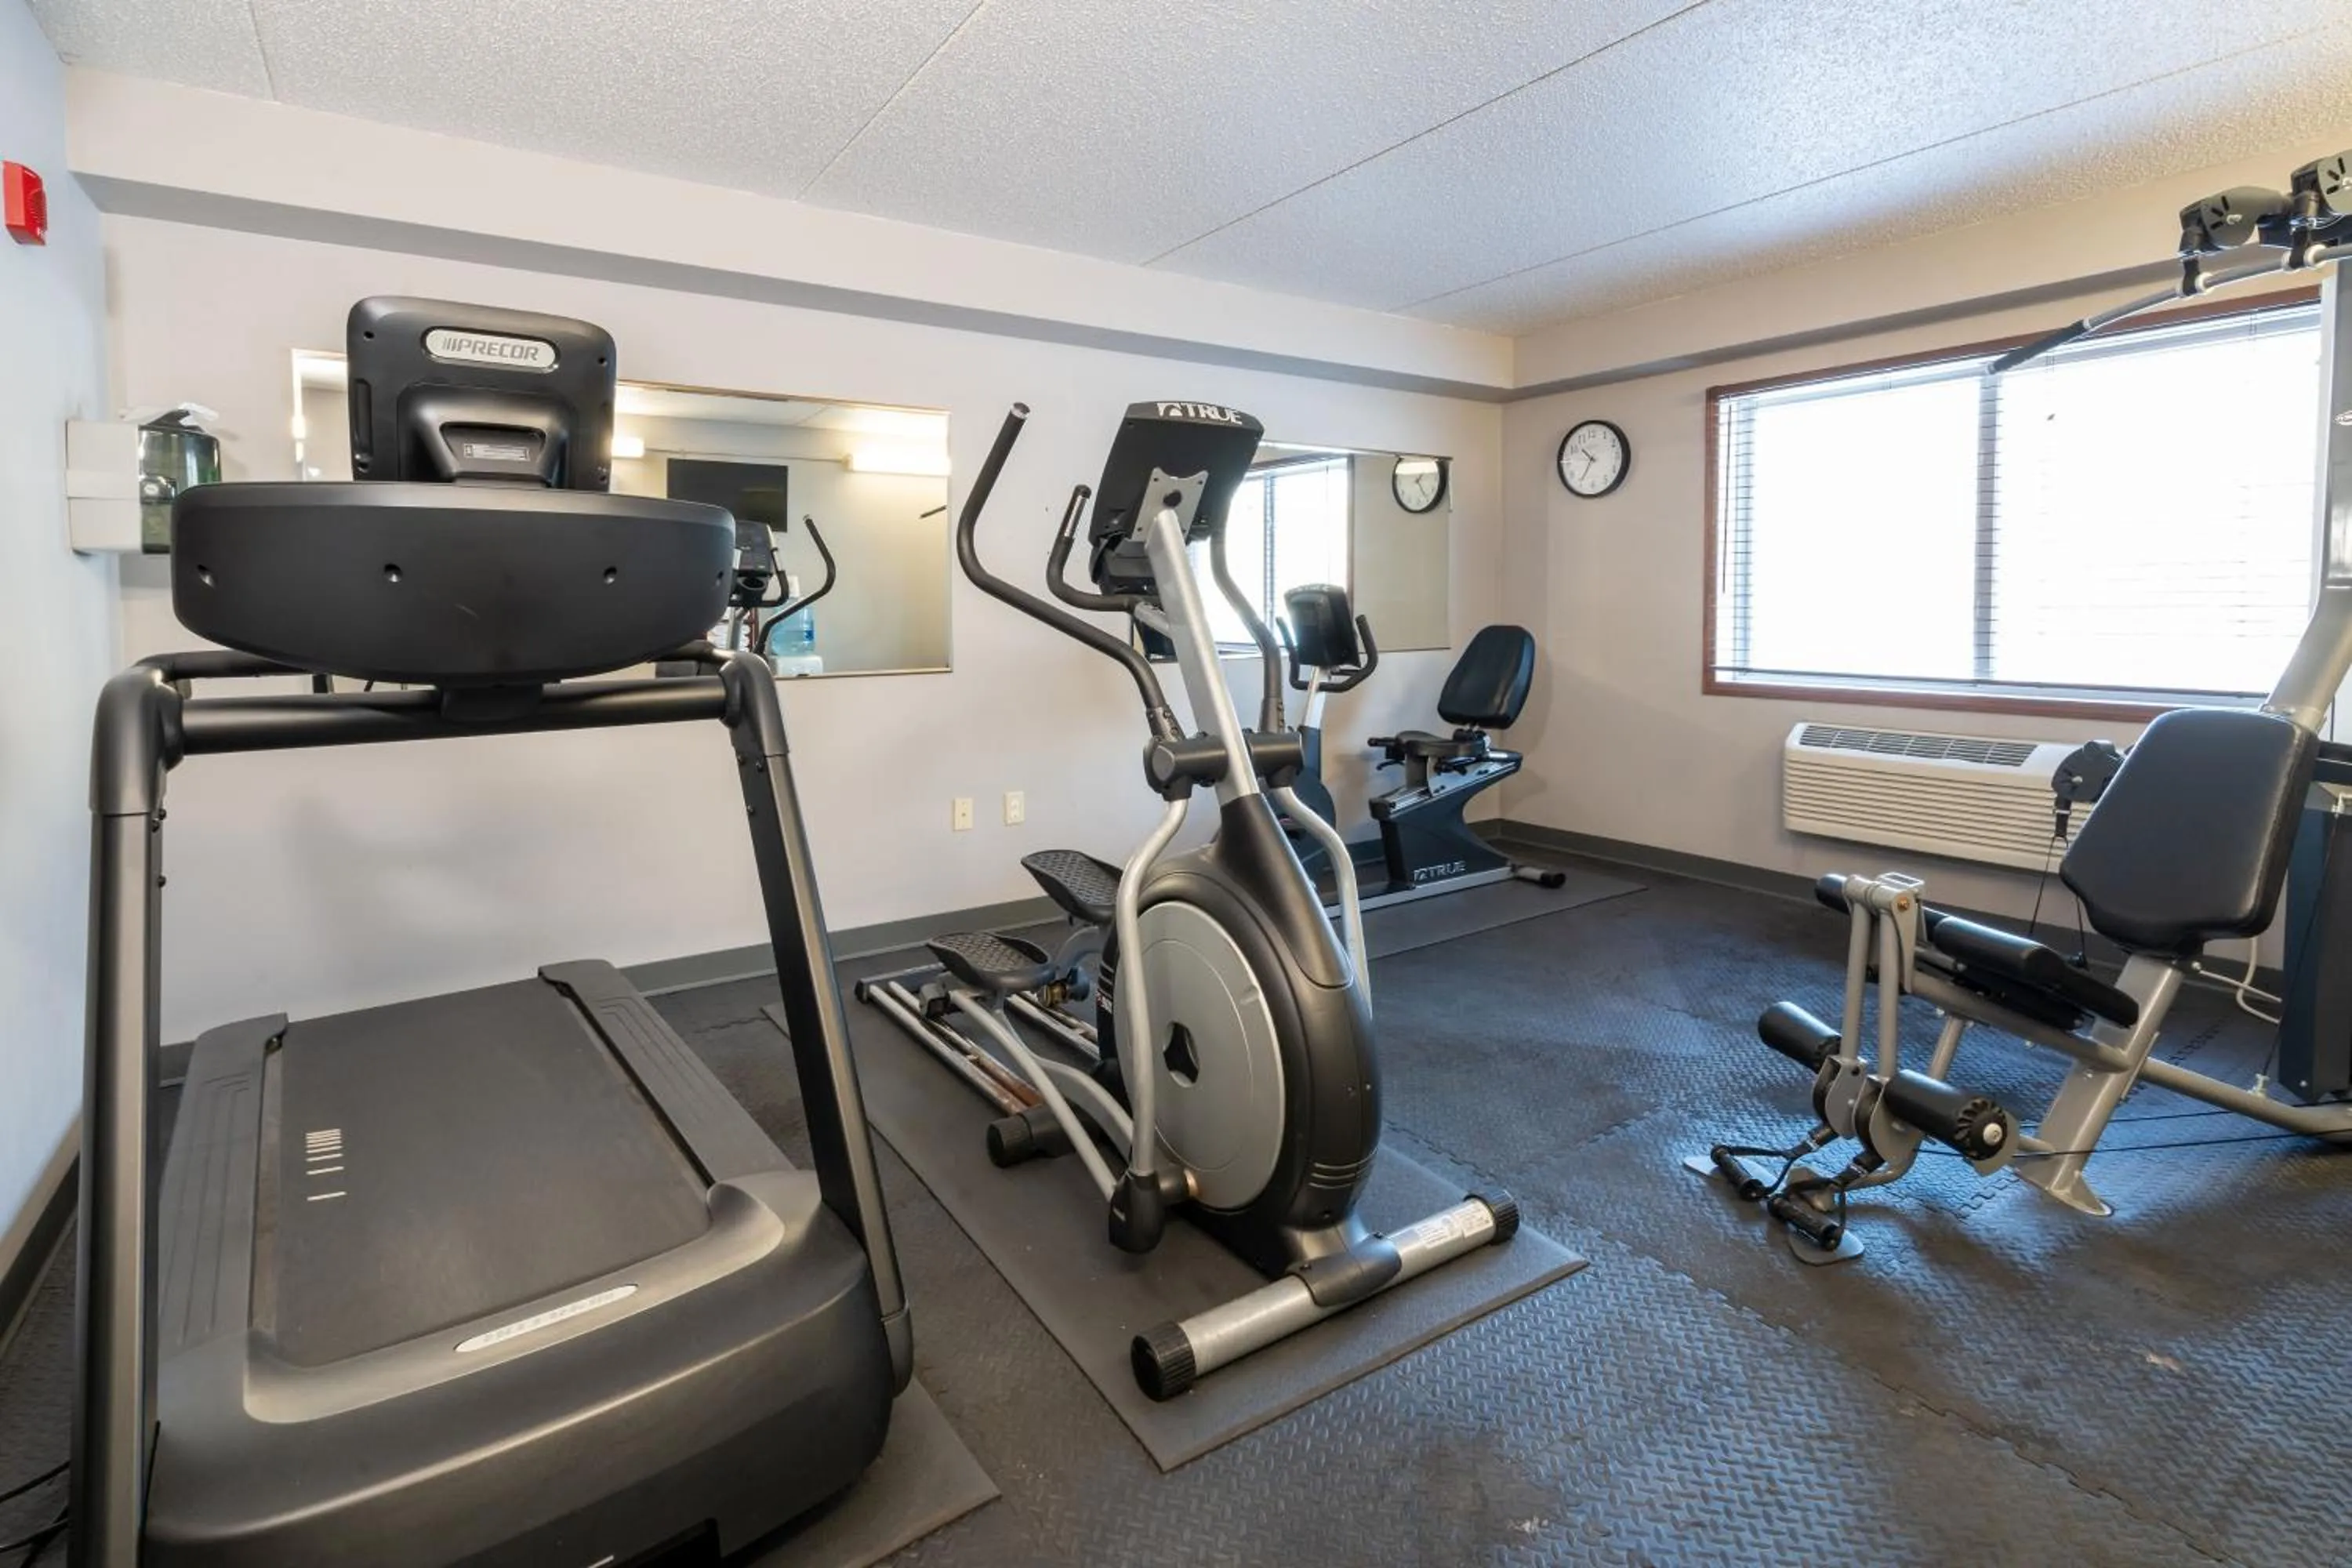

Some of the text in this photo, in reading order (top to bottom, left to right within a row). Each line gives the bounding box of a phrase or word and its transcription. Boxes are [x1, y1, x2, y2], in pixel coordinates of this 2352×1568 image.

[456, 338, 539, 361] PRECOR
[1181, 402, 1243, 425] TRUE
[1428, 861, 1466, 877] TRUE
